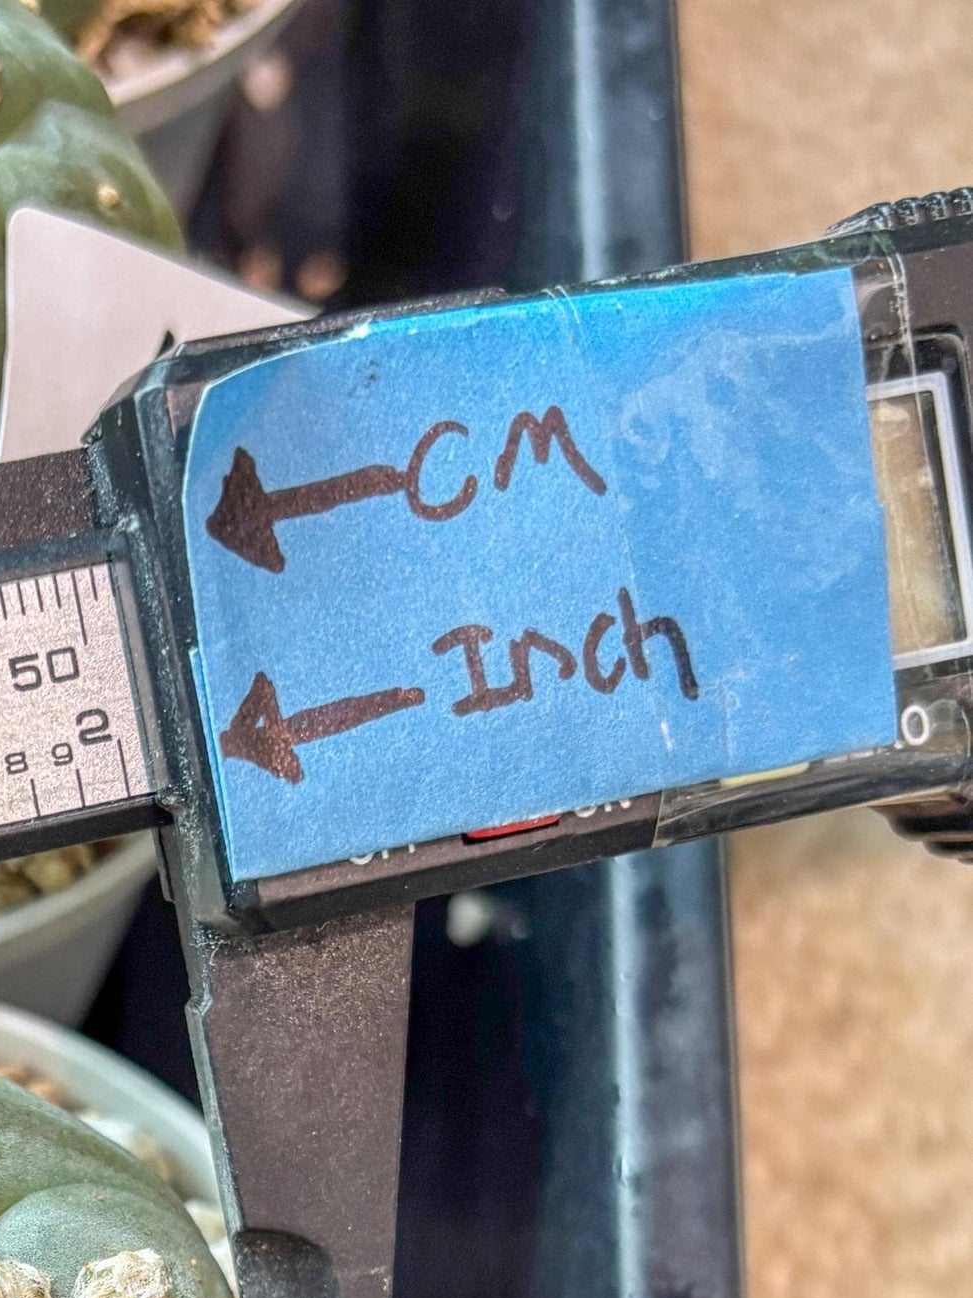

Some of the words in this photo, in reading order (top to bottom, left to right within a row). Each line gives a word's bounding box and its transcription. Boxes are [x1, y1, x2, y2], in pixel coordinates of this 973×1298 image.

[8, 646, 80, 692] 50
[433, 588, 698, 714] Inch
[5, 751, 29, 775] 8
[51, 743, 73, 766] 9
[76, 708, 112, 746] 2
